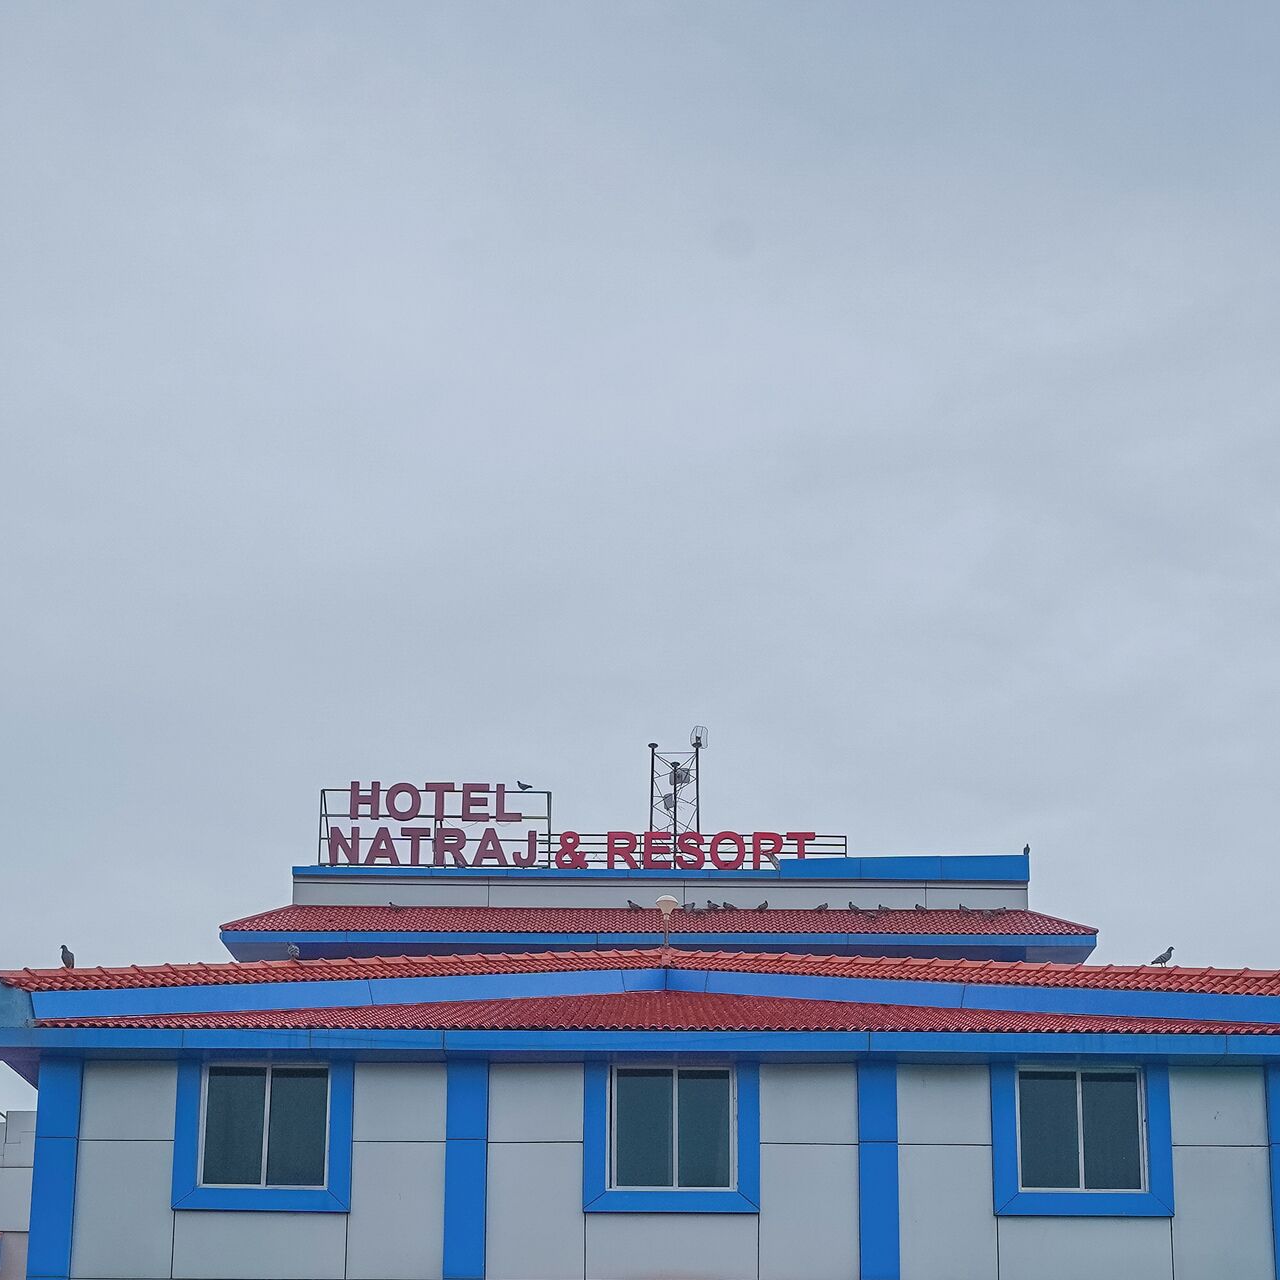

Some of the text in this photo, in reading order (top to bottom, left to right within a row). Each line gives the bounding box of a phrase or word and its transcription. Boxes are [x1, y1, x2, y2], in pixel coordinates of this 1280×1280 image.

[349, 781, 522, 822] HOTEL
[328, 827, 816, 870] NATRAJ & RESORT
